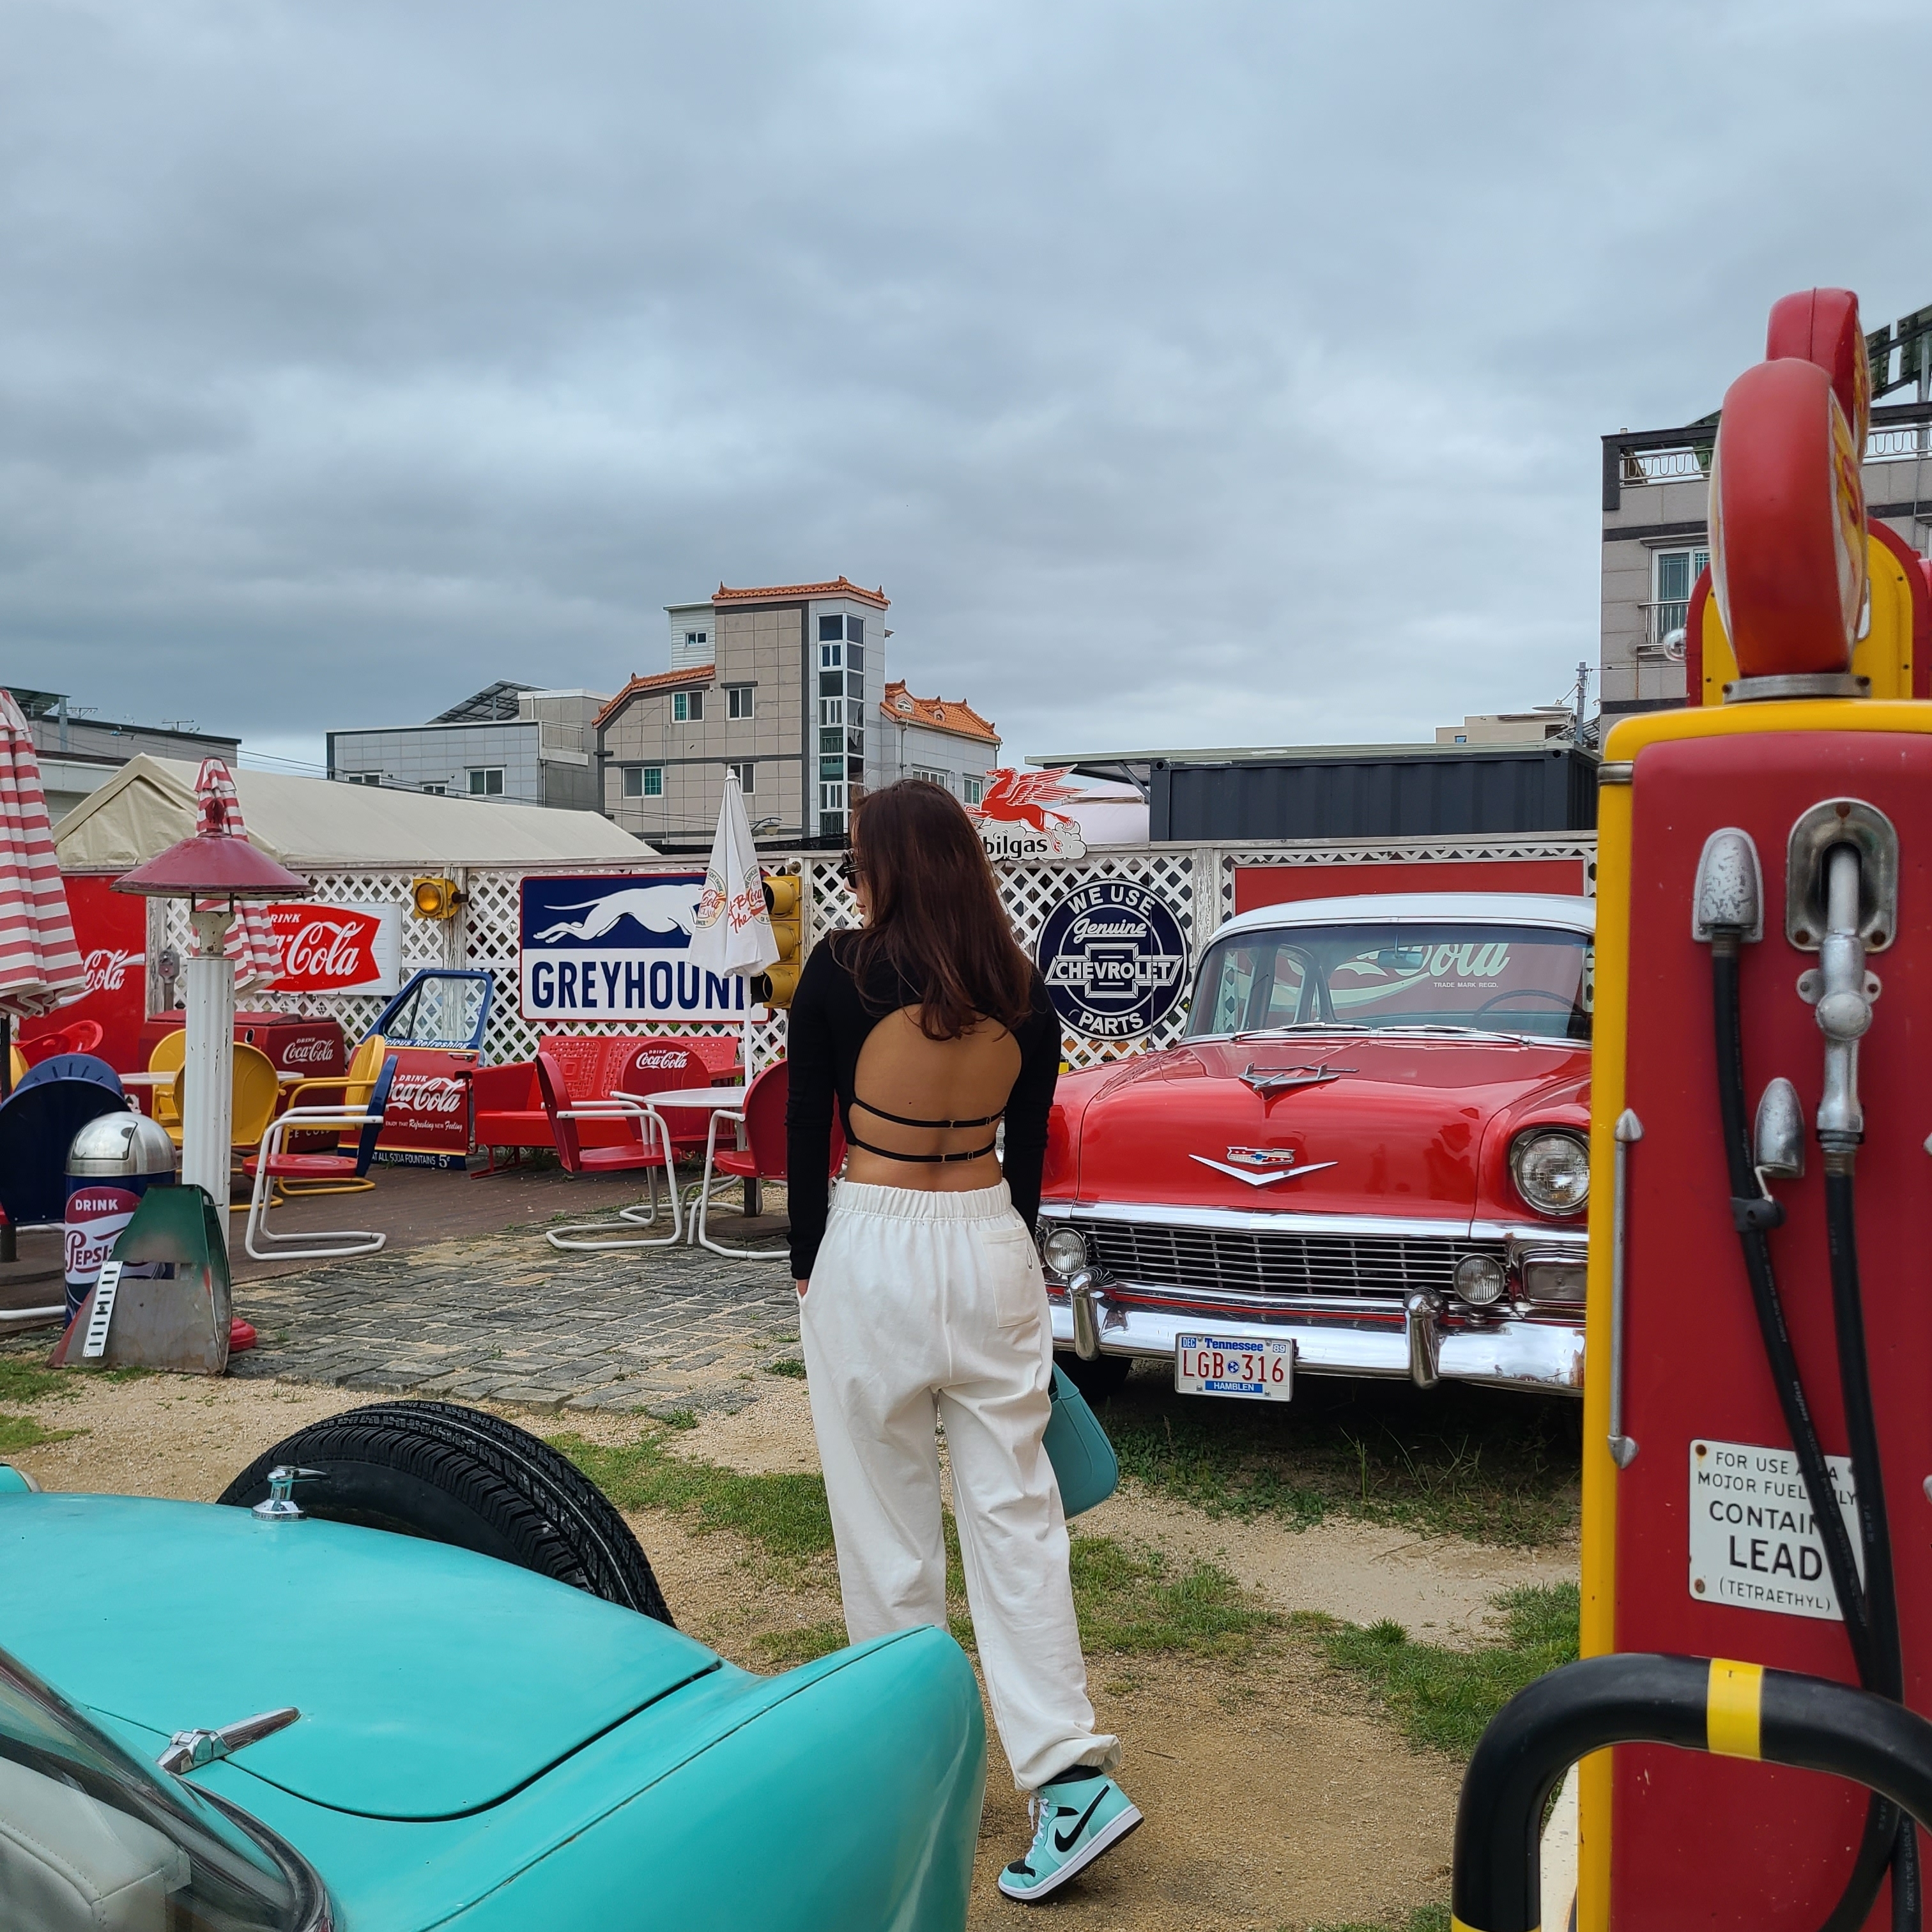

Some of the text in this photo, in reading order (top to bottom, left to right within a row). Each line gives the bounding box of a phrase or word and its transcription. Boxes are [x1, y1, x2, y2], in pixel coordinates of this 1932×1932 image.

[983, 836, 1048, 858] bilgas
[1067, 886, 1155, 916] WE USE
[271, 914, 302, 923] RINK
[1073, 918, 1147, 944] Genuine
[1055, 962, 1170, 979] CHEVROLET
[1078, 1011, 1143, 1034] PARTS
[282, 1039, 335, 1065] Coca-Cola
[414, 1039, 470, 1050] Refreshing
[636, 1052, 689, 1069] Coca-Cola
[409, 1119, 434, 1131] Refreshing
[445, 1121, 463, 1133] Feeling
[378, 1153, 389, 1162] ALL
[390, 1153, 404, 1163] SODA
[405, 1154, 436, 1165] FOUNTAINS
[75, 1199, 118, 1211] DRINK
[1183, 1338, 1195, 1347] DEC
[1204, 1338, 1263, 1351] Tennessee
[1273, 1344, 1285, 1353] 89
[1183, 1350, 1284, 1383] LGB 316
[1214, 1382, 1254, 1391] HAMBLEN
[1716, 1452, 1747, 1469] FOR
[1756, 1457, 1788, 1475] USE
[1698, 1471, 1756, 1493] MOTOR
[1764, 1481, 1807, 1499] FUEL
[1729, 1535, 1822, 1582] LEAD
[1719, 1576, 1831, 1612] (TETRAETHYL)
